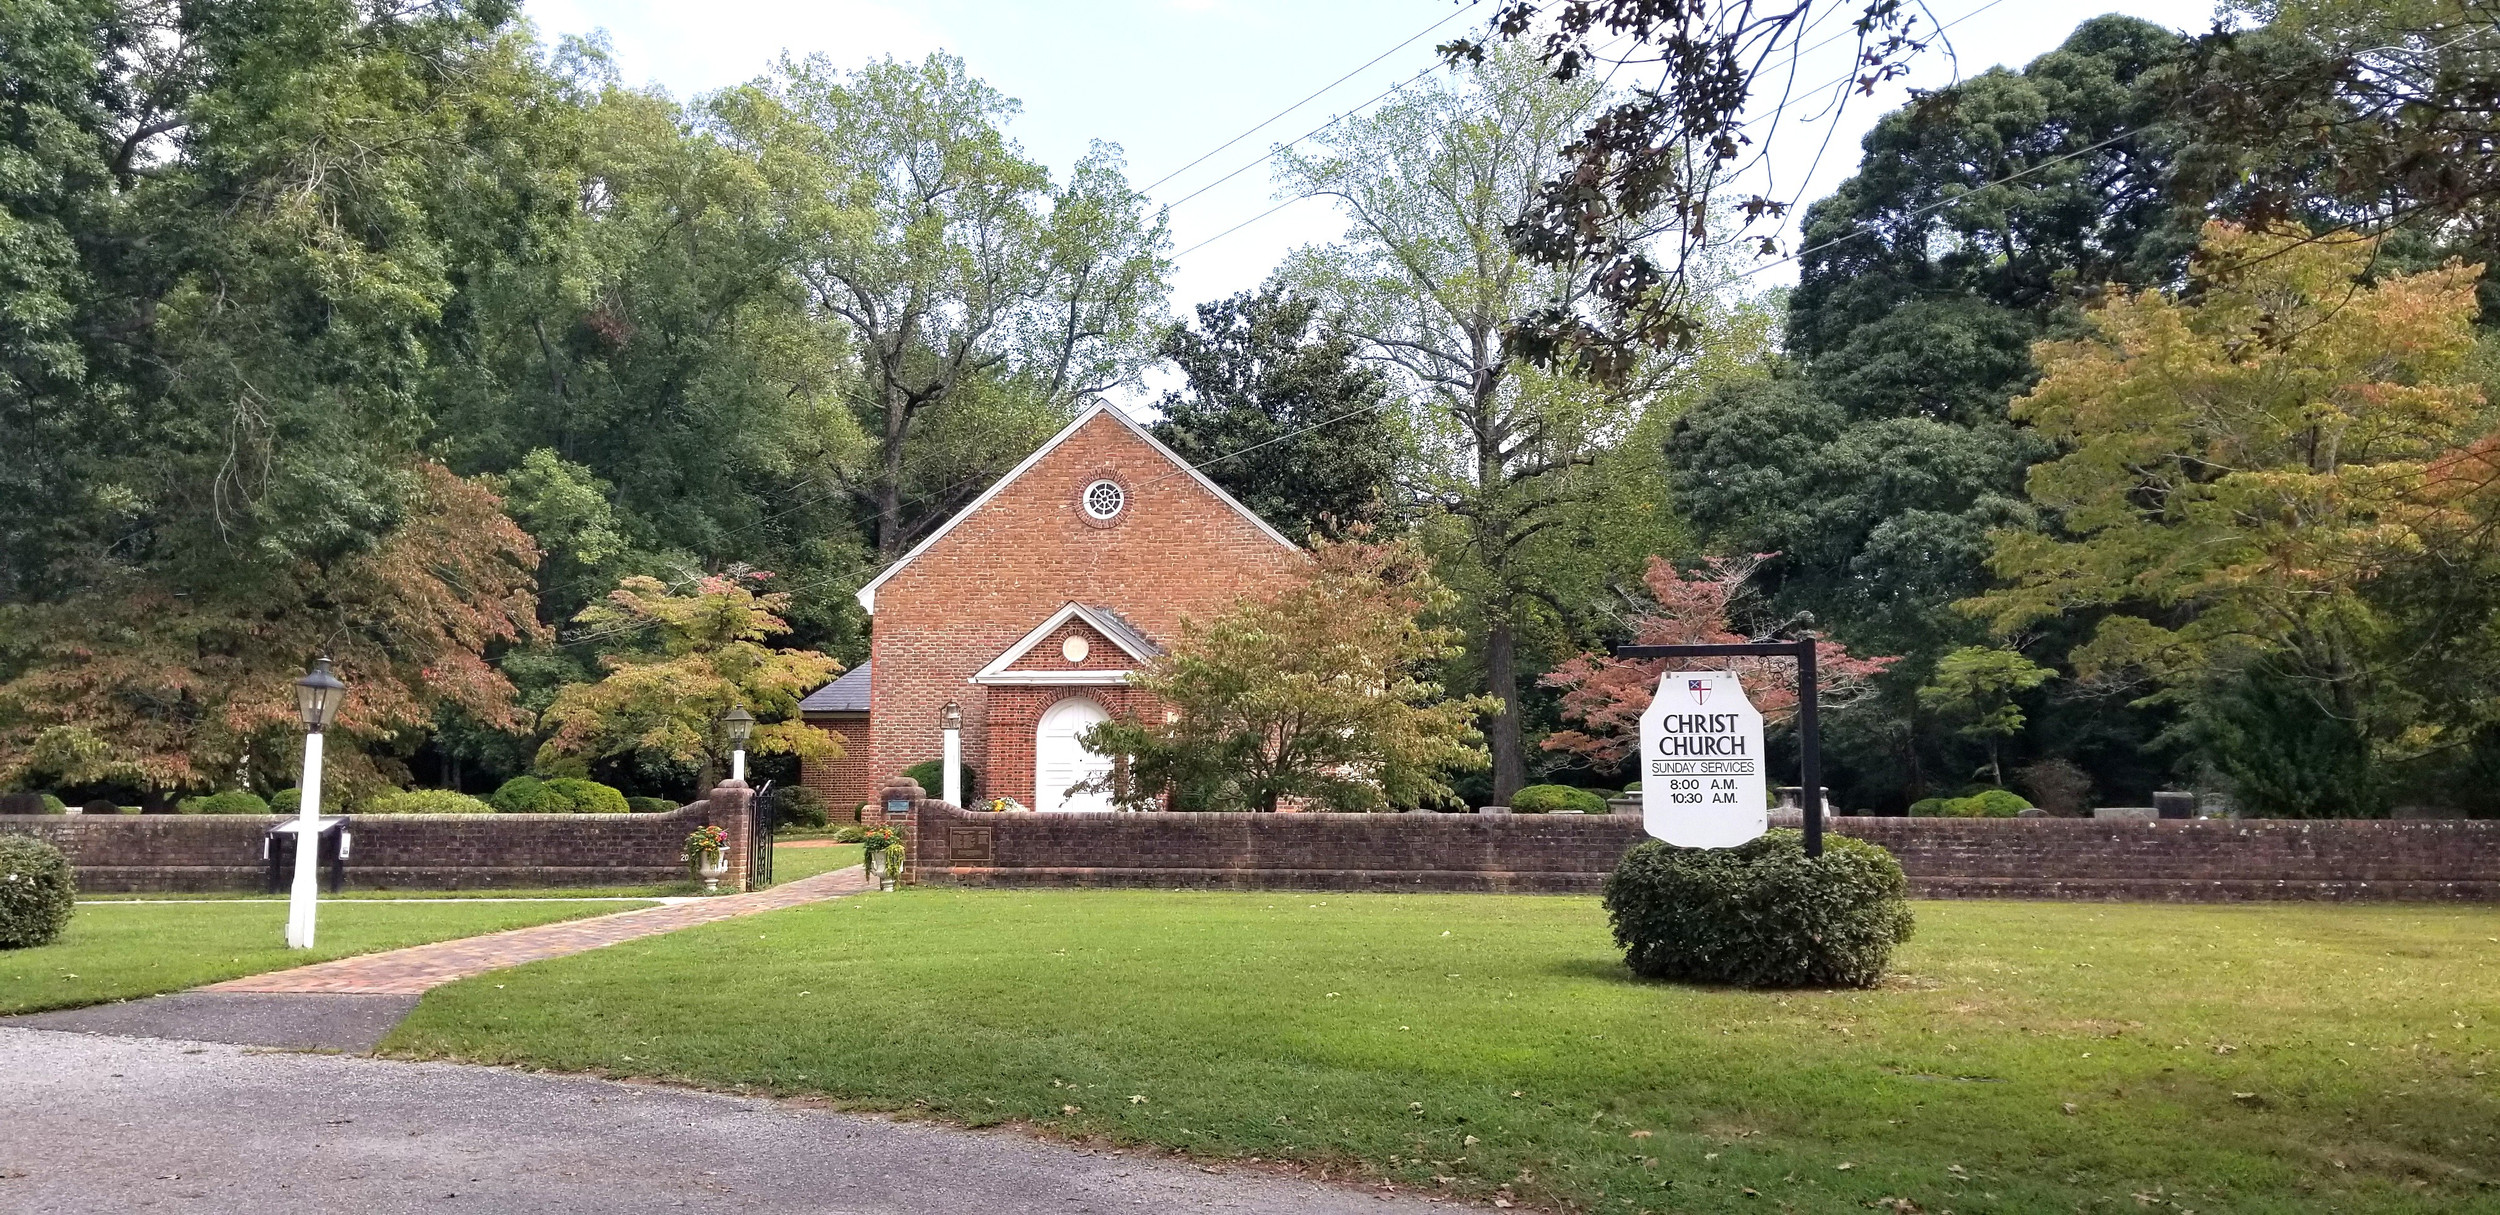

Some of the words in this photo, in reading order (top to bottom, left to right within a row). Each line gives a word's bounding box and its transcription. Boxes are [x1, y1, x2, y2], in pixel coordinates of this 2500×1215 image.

[1663, 714, 1739, 733] CHRIST
[1659, 735, 1746, 756] CHURCH
[1652, 762, 1696, 773] SUNDAY
[1700, 762, 1755, 773] SERVICES
[1670, 779, 1700, 790] 8:00
[1710, 779, 1738, 790] A.M.
[1671, 793, 1703, 804] 10:30
[1712, 793, 1738, 804] A.M.
